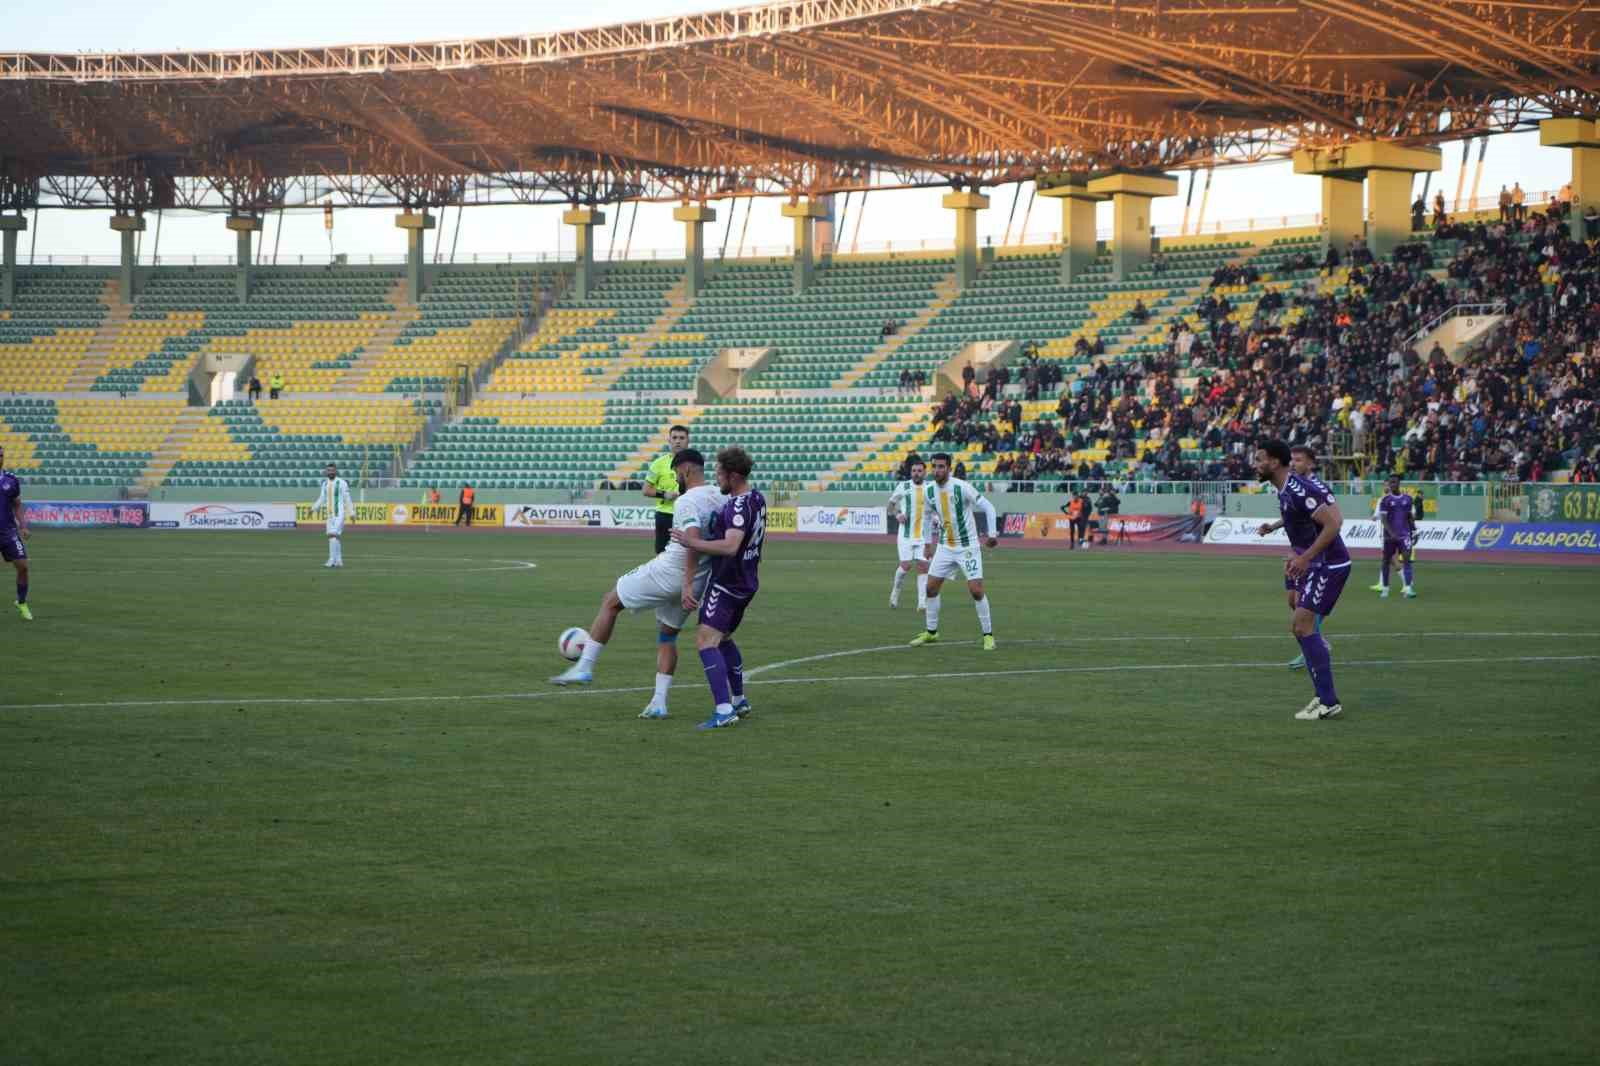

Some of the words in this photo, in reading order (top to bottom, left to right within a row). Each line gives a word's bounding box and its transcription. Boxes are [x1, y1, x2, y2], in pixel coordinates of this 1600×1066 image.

[817, 511, 835, 527] Gap
[850, 511, 881, 526] Turizm
[1510, 530, 1600, 549] KASAPOĞL
[965, 559, 979, 572] 82
